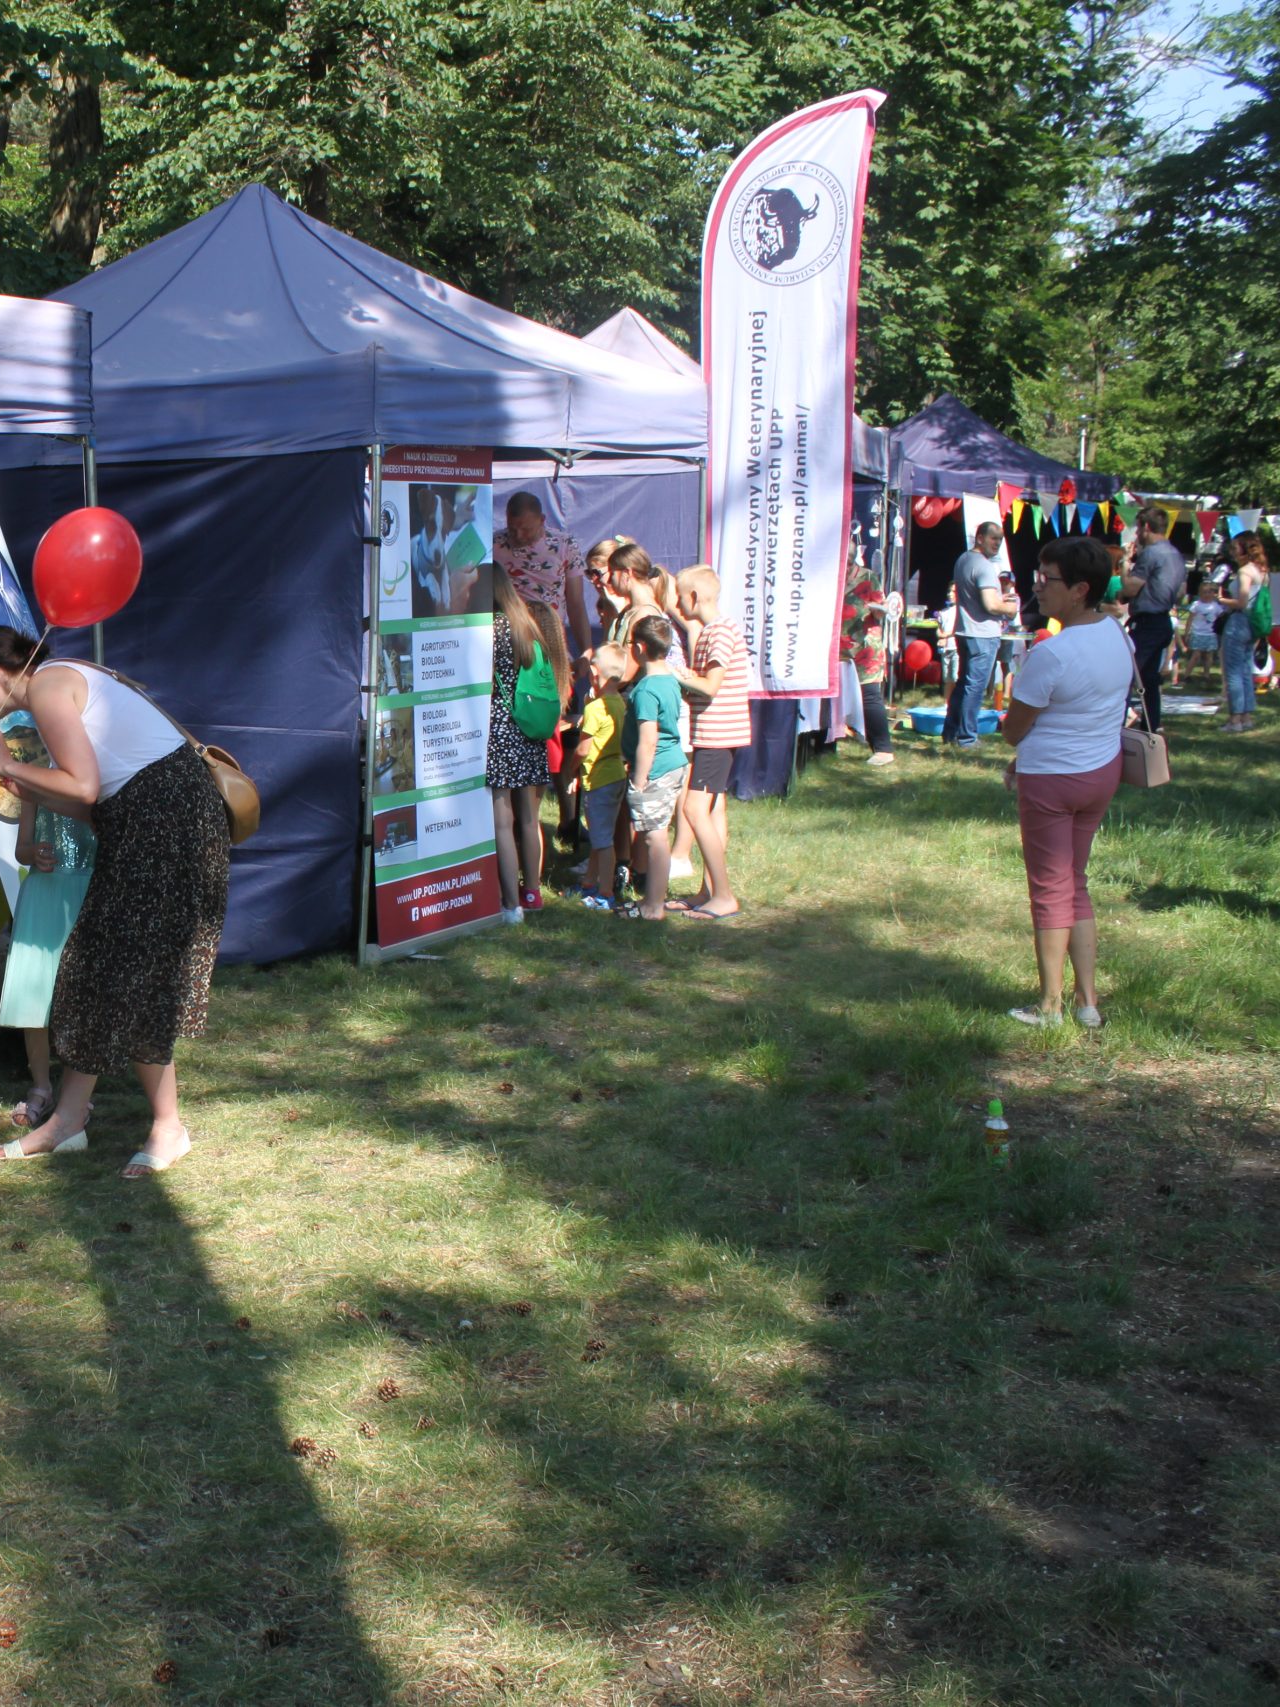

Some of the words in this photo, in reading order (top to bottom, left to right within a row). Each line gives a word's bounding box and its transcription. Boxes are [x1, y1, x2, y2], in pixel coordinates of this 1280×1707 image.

[746, 311, 767, 478] Weterynaryjnej
[770, 408, 783, 449] UPP
[414, 465, 455, 476] PRZYRODNICZEGO
[455, 467, 460, 475] W
[461, 467, 485, 477] POZNANIU
[765, 458, 783, 588] Zwierzętach
[745, 485, 762, 589] Medycyny
[784, 404, 811, 678] www1.up.poznan.pl/animal/
[743, 598, 759, 667] ydział
[421, 640, 460, 652] AGROTURYSTYKA
[421, 656, 446, 666] BIOLOGIA
[421, 668, 456, 680] ZOOTECHNIKA
[422, 709, 447, 721] BIOLOGIA
[422, 720, 462, 735] NEUROBIOLOGIA
[423, 736, 453, 749] TURYSTYKA
[454, 729, 483, 743] PRZYRODNICZA
[423, 749, 459, 763] ZOOTECHNIKA
[425, 818, 462, 834] WETERYNARIA
[397, 871, 482, 904] www.UP.POZNAN.PL/ANIMAL
